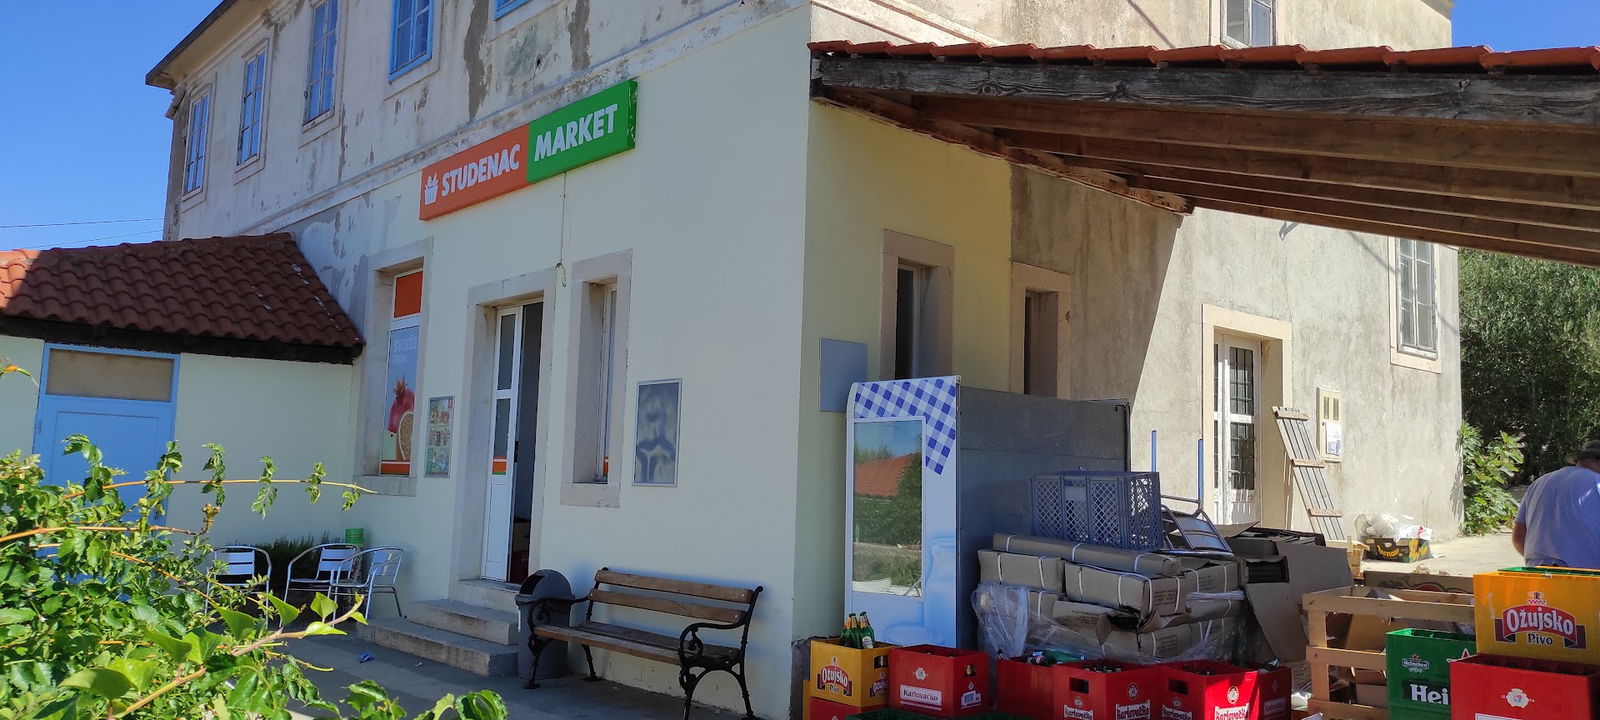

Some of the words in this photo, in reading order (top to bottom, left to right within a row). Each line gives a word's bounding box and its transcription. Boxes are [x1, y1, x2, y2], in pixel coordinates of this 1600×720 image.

[441, 144, 520, 196] STUDENAC
[534, 104, 618, 161] MARKET
[1506, 607, 1574, 635] Ožujsko
[1528, 633, 1553, 645] Pivo
[1409, 683, 1450, 705] Hei
